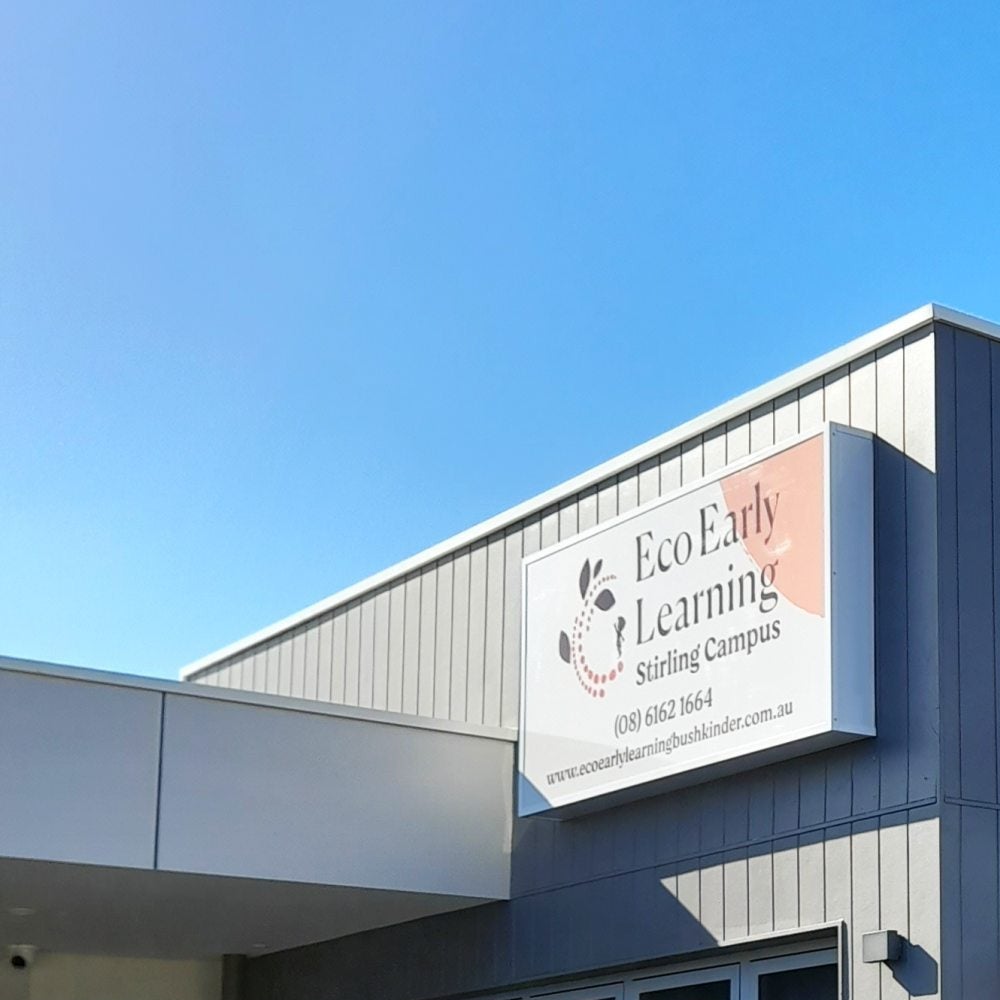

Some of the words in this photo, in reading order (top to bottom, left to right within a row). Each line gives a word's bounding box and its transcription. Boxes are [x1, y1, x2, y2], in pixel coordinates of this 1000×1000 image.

[635, 530, 692, 582] Eco
[700, 481, 780, 557] Early
[636, 558, 779, 645] Learning
[636, 643, 700, 686] Stirling
[705, 619, 781, 662] Campus
[546, 701, 793, 785] www.ecoearlylearningbushkinder.com.au
[614, 712, 641, 739] (08)
[645, 698, 676, 728] 6162
[680, 687, 713, 719] 1664
